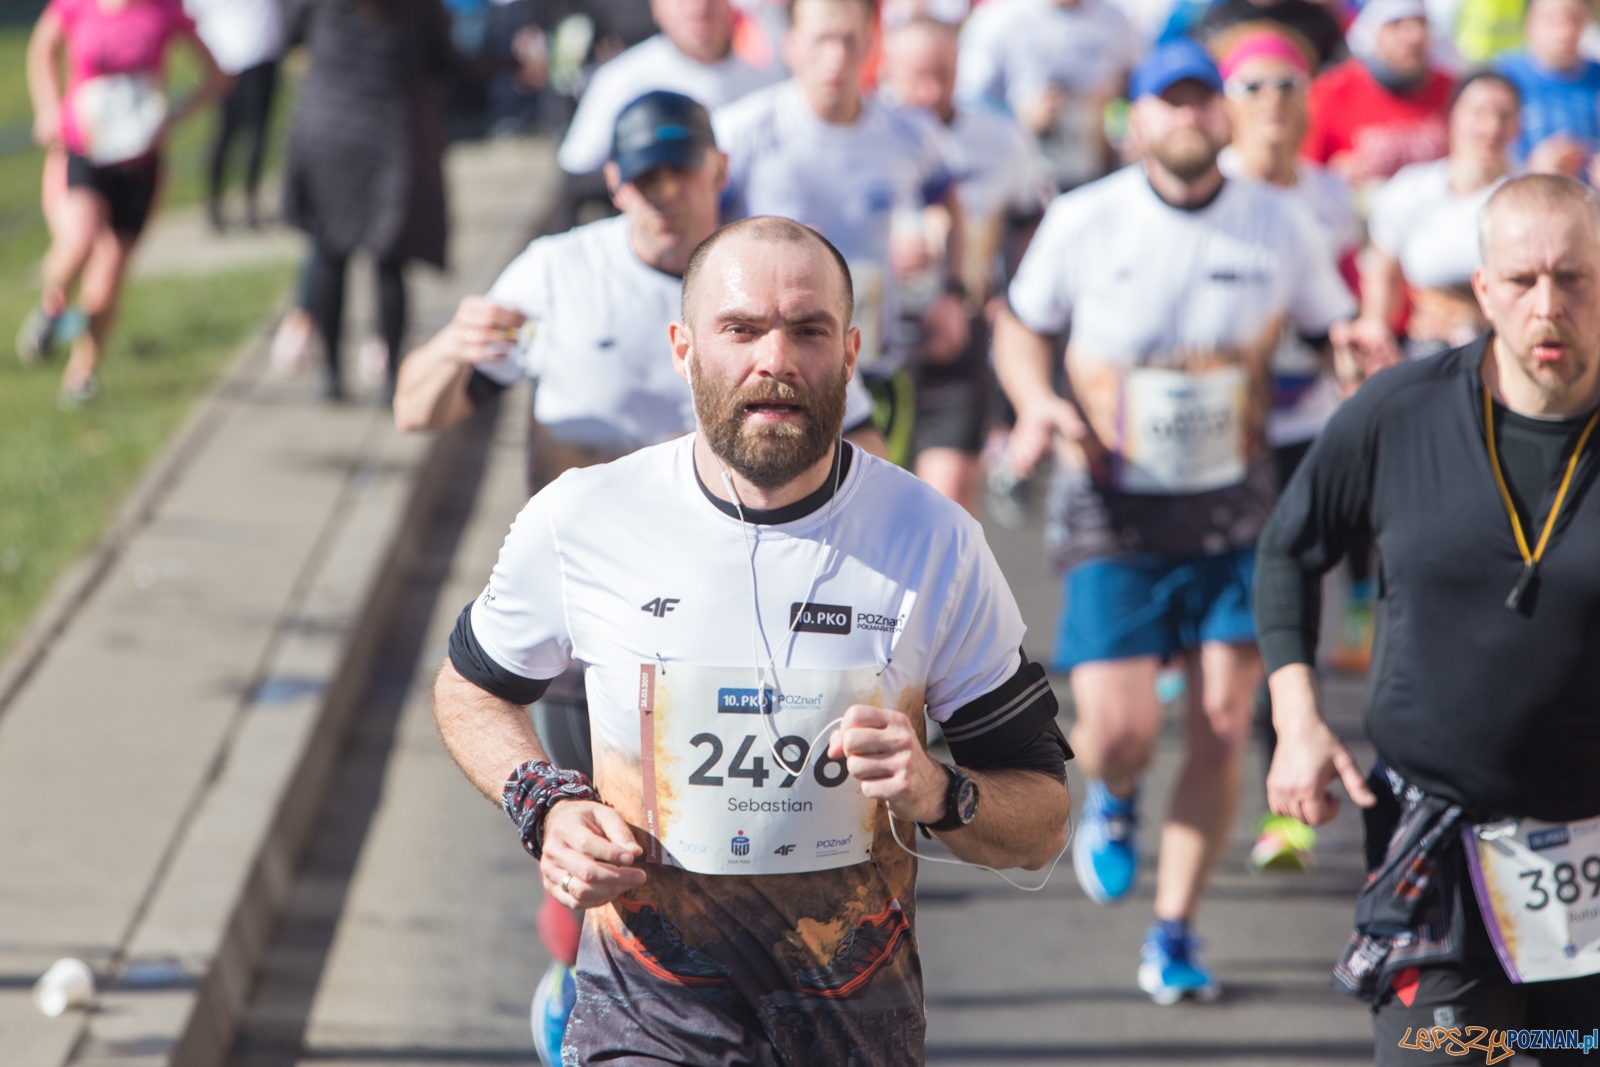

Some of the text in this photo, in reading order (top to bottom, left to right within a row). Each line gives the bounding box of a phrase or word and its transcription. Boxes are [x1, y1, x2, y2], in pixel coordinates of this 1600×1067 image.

[641, 597, 681, 618] 4F
[817, 612, 847, 626] PKO
[640, 672, 649, 708] 26.03.2017
[723, 695, 769, 708] 10. PKO
[689, 732, 850, 788] 2496
[727, 797, 813, 813] Sebastian
[774, 844, 797, 856] 4F
